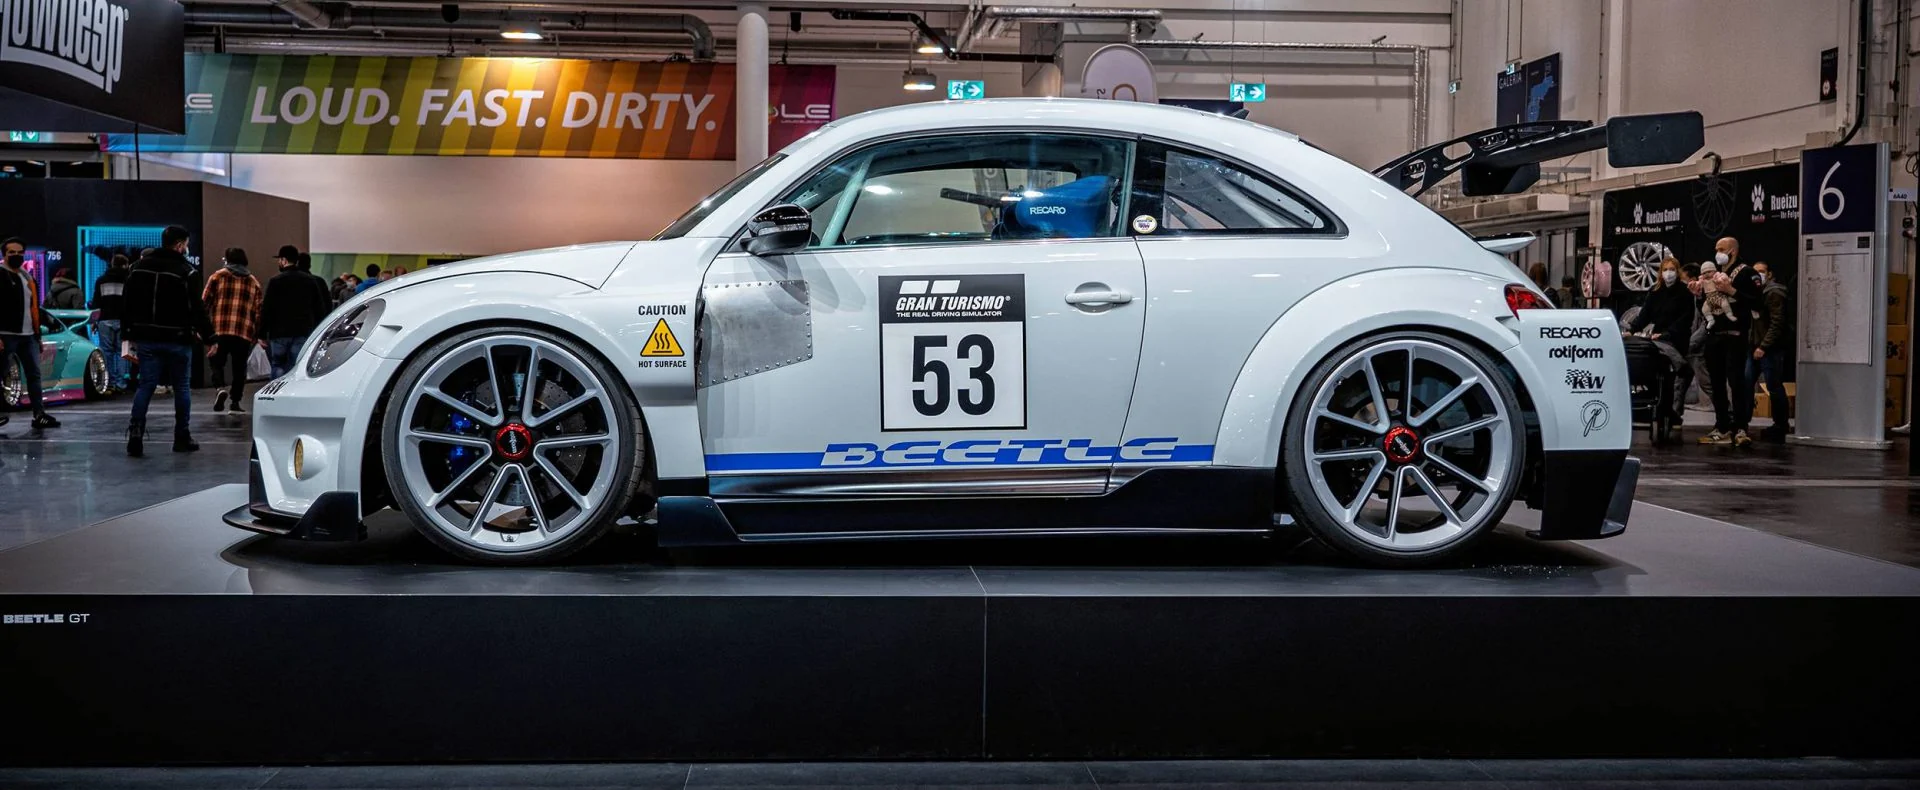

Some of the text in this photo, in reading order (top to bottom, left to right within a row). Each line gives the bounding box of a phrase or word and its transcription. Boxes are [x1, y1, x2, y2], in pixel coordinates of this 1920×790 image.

[250, 86, 717, 131] LOUD. FAST. DIRTY.
[1818, 161, 1845, 221] 6
[1771, 193, 1798, 210] Rueizu
[1030, 206, 1066, 215] RECARO
[638, 305, 687, 316] CAUTION
[896, 297, 937, 311] GRAN
[1540, 327, 1602, 339] RECARO
[1549, 345, 1603, 363] rotiform
[911, 334, 996, 418] 53
[1571, 376, 1606, 389] KW
[820, 437, 1179, 466] BEETLE
[3, 613, 91, 624] BEETLE GT
